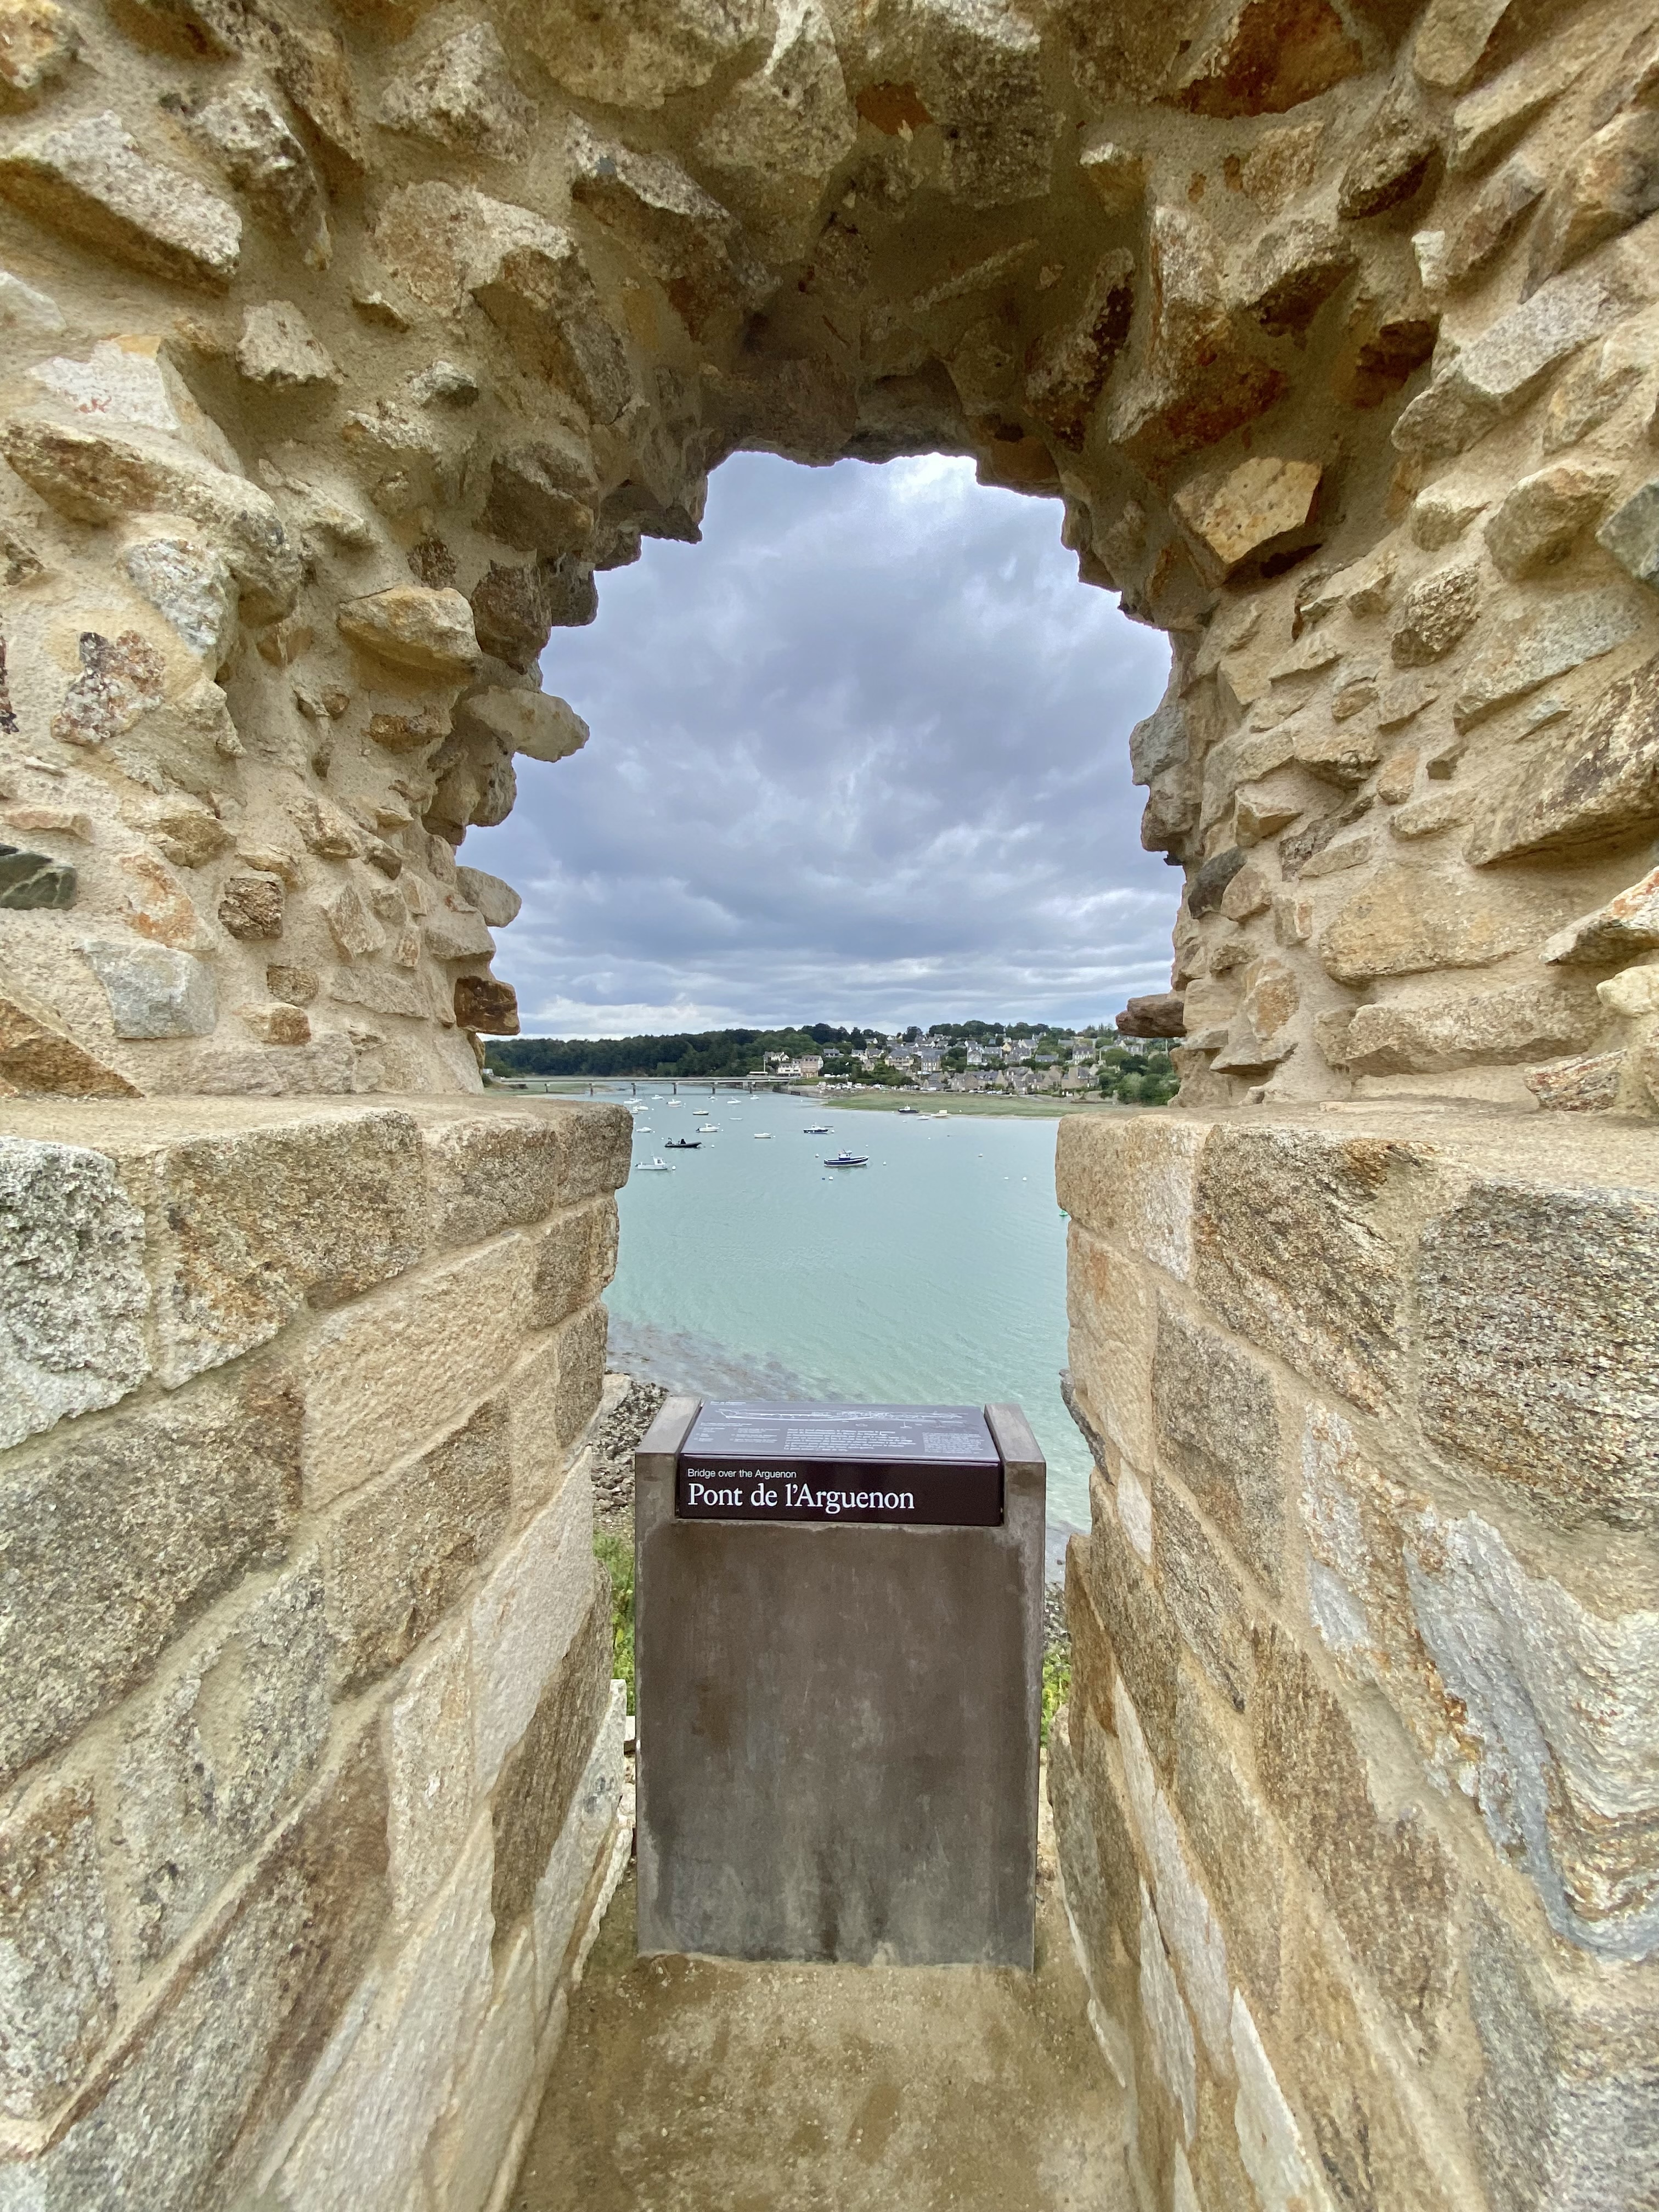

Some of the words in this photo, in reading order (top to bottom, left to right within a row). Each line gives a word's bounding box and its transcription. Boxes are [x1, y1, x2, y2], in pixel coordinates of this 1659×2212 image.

[687, 1468, 716, 1480] Bridge
[738, 1469, 753, 1478] the
[754, 1469, 797, 1481] Arguenon
[687, 1483, 743, 1506] Pont
[751, 1482, 778, 1507] de
[785, 1483, 916, 1514] l'Arguenon
